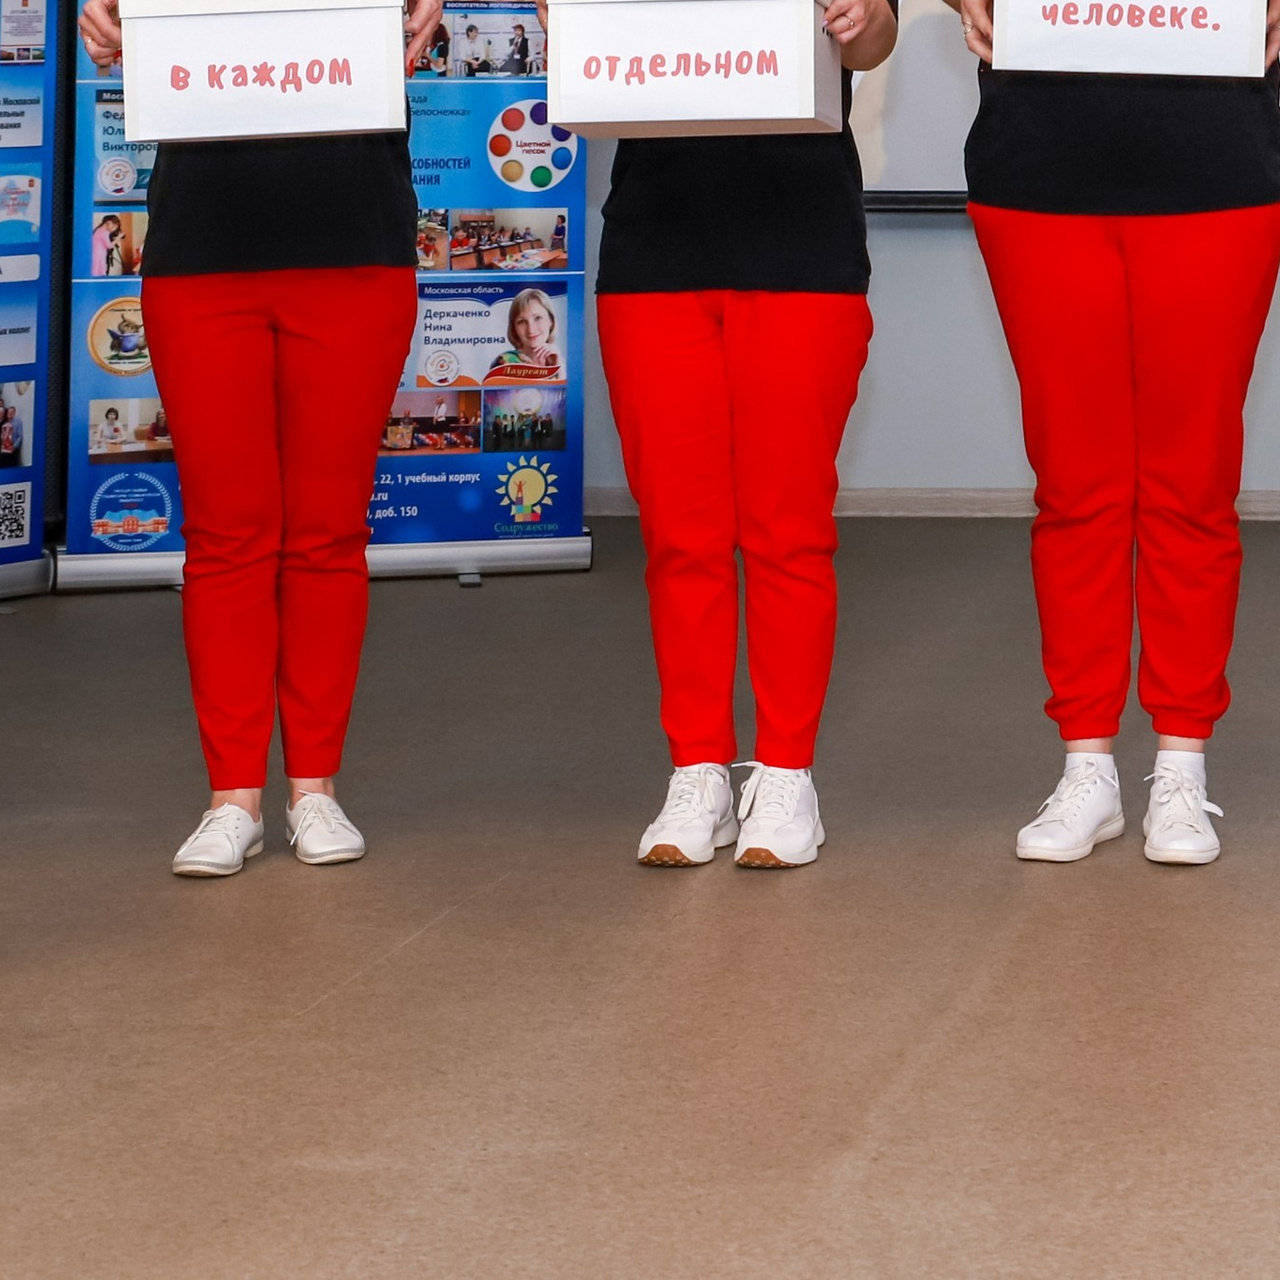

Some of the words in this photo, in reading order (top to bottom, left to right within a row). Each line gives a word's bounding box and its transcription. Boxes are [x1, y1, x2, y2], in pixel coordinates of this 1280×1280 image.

[1041, 2, 1222, 31] человеке.
[583, 49, 779, 85] отдельном
[170, 65, 191, 91] в
[207, 58, 353, 93] каждом
[408, 96, 428, 104] ада
[515, 140, 551, 148] Цветной
[424, 287, 472, 295] Московская
[473, 286, 504, 294] область
[424, 309, 491, 320] Деркаченко
[424, 323, 452, 332] Нина
[424, 336, 506, 347] Владимировна
[502, 366, 549, 375] Лауреат
[380, 475, 395, 485] 22,
[397, 474, 402, 483] 1
[404, 472, 448, 486] учебный
[449, 472, 481, 484] корпус
[375, 507, 398, 519] доб.
[400, 506, 418, 517] 150
[493, 522, 559, 534] Содружество
